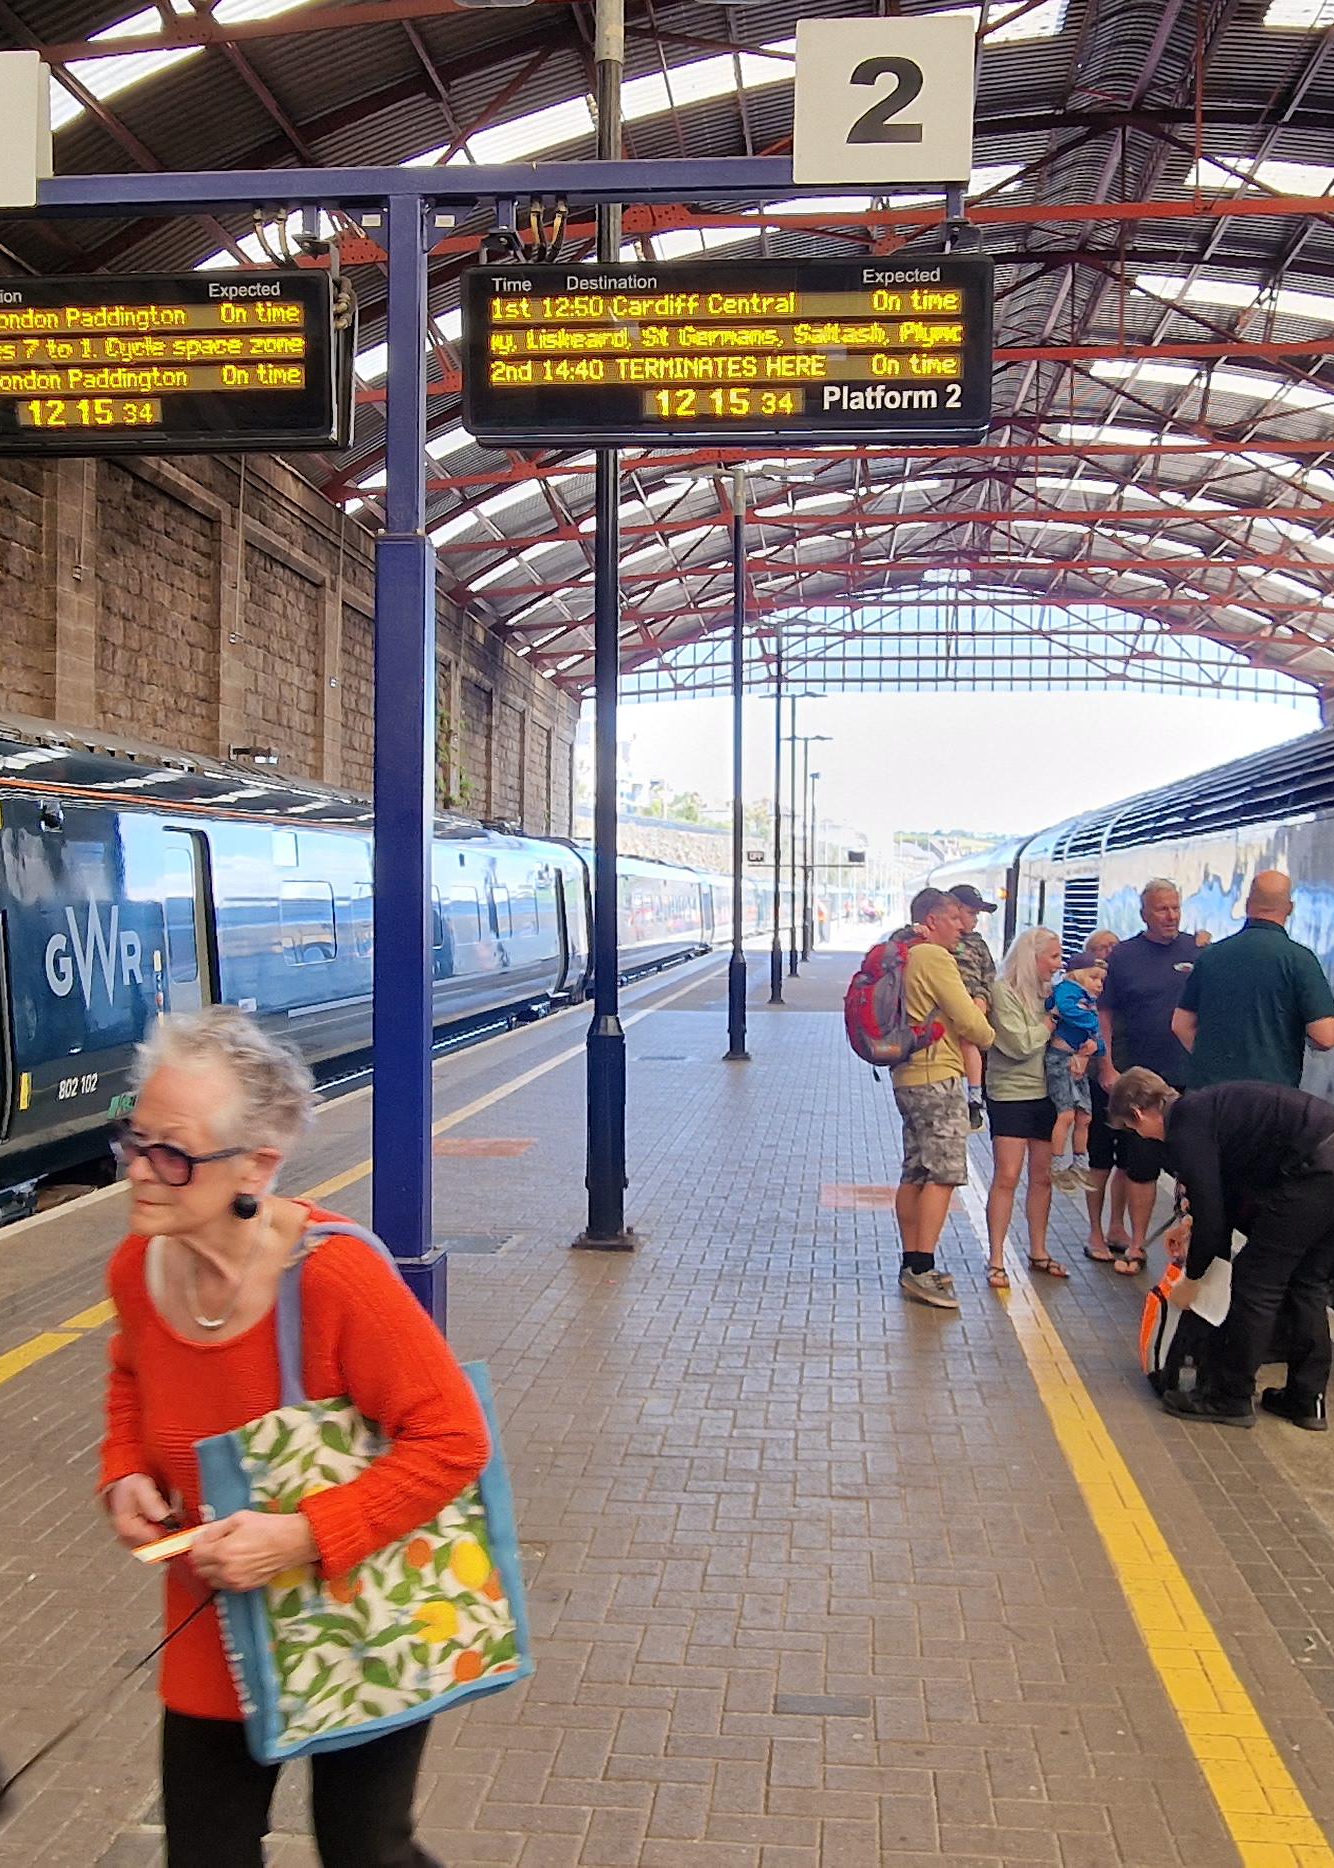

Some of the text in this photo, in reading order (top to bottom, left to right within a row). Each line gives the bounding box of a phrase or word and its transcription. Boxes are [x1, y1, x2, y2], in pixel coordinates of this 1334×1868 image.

[846, 56, 924, 144] 2
[208, 281, 281, 300] Expected
[492, 267, 941, 292] Time Destination Expected
[65, 305, 187, 331] Paddington
[219, 303, 248, 324] On
[254, 301, 301, 323] time
[492, 289, 959, 320] 1st 12:50 Cardiff Central On time
[23, 338, 40, 359] 7
[45, 338, 74, 360] to
[104, 336, 167, 362] Cycle
[172, 335, 244, 361] space
[640, 325, 670, 347] St
[67, 367, 188, 393] Paddington
[221, 364, 250, 386] On
[256, 363, 303, 385] time
[491, 352, 958, 383] 2nd 14:40 TERMINATES HERE On time
[656, 387, 794, 417] 12 15 34
[823, 383, 963, 411] Platform 2
[28, 398, 154, 426] 12 15 34
[45, 886, 144, 1012] GWR
[58, 1072, 98, 1100] 802 102
